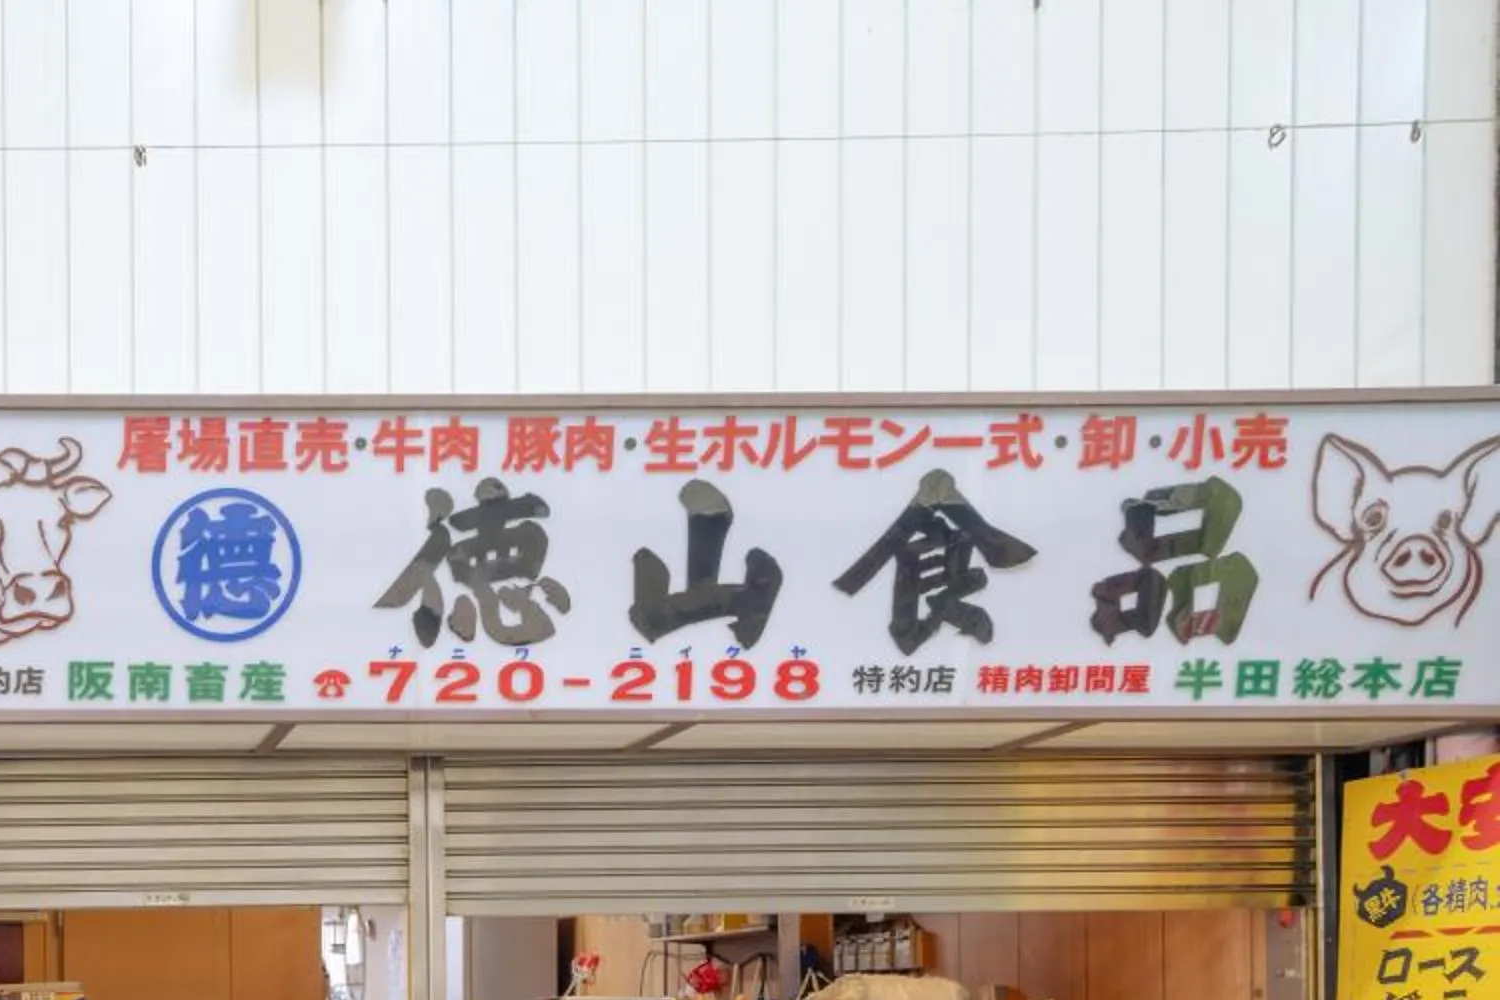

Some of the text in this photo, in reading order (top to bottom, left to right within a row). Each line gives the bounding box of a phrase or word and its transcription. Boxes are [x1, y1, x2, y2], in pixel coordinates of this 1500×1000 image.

[67, 661, 286, 702] 阪南畜産
[852, 657, 1463, 700] 特約店 精肉卸問屋 半田総本店
[1377, 947, 1486, 984] ロース
